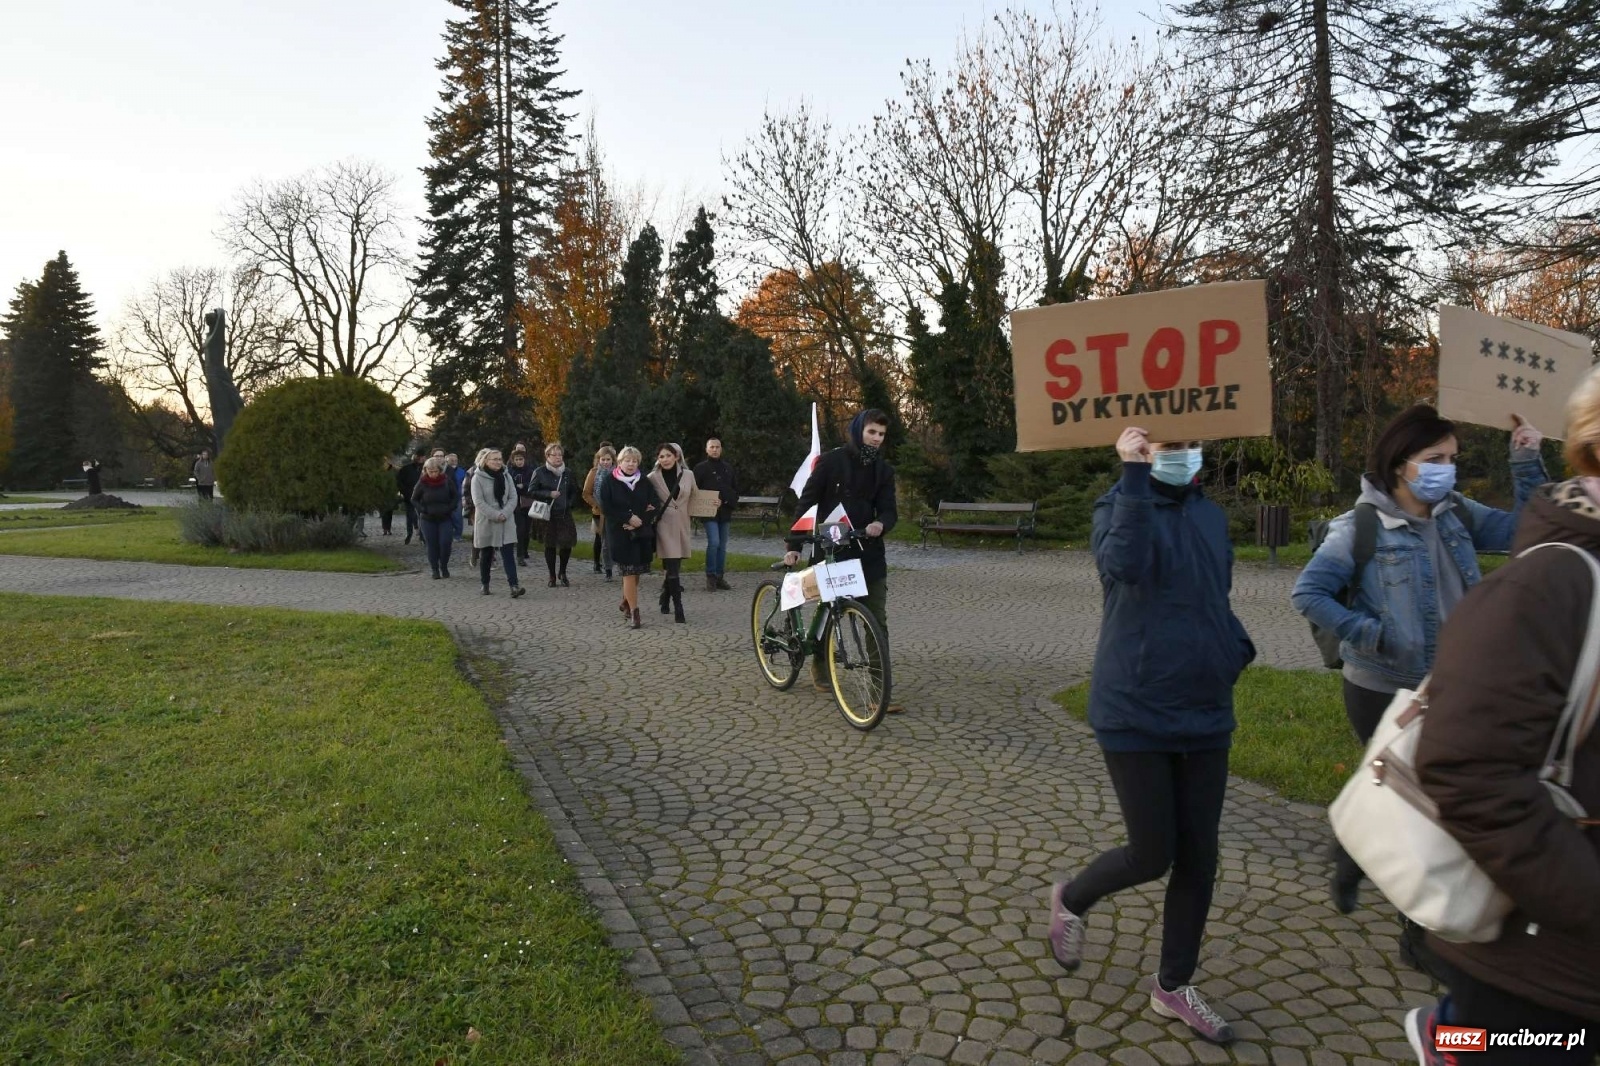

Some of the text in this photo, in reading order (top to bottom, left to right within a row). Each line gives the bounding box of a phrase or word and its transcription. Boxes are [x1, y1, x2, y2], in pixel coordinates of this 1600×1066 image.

[1045, 319, 1241, 400] STOP
[1052, 384, 1240, 426] DYKTATURZE
[825, 573, 856, 585] STOP
